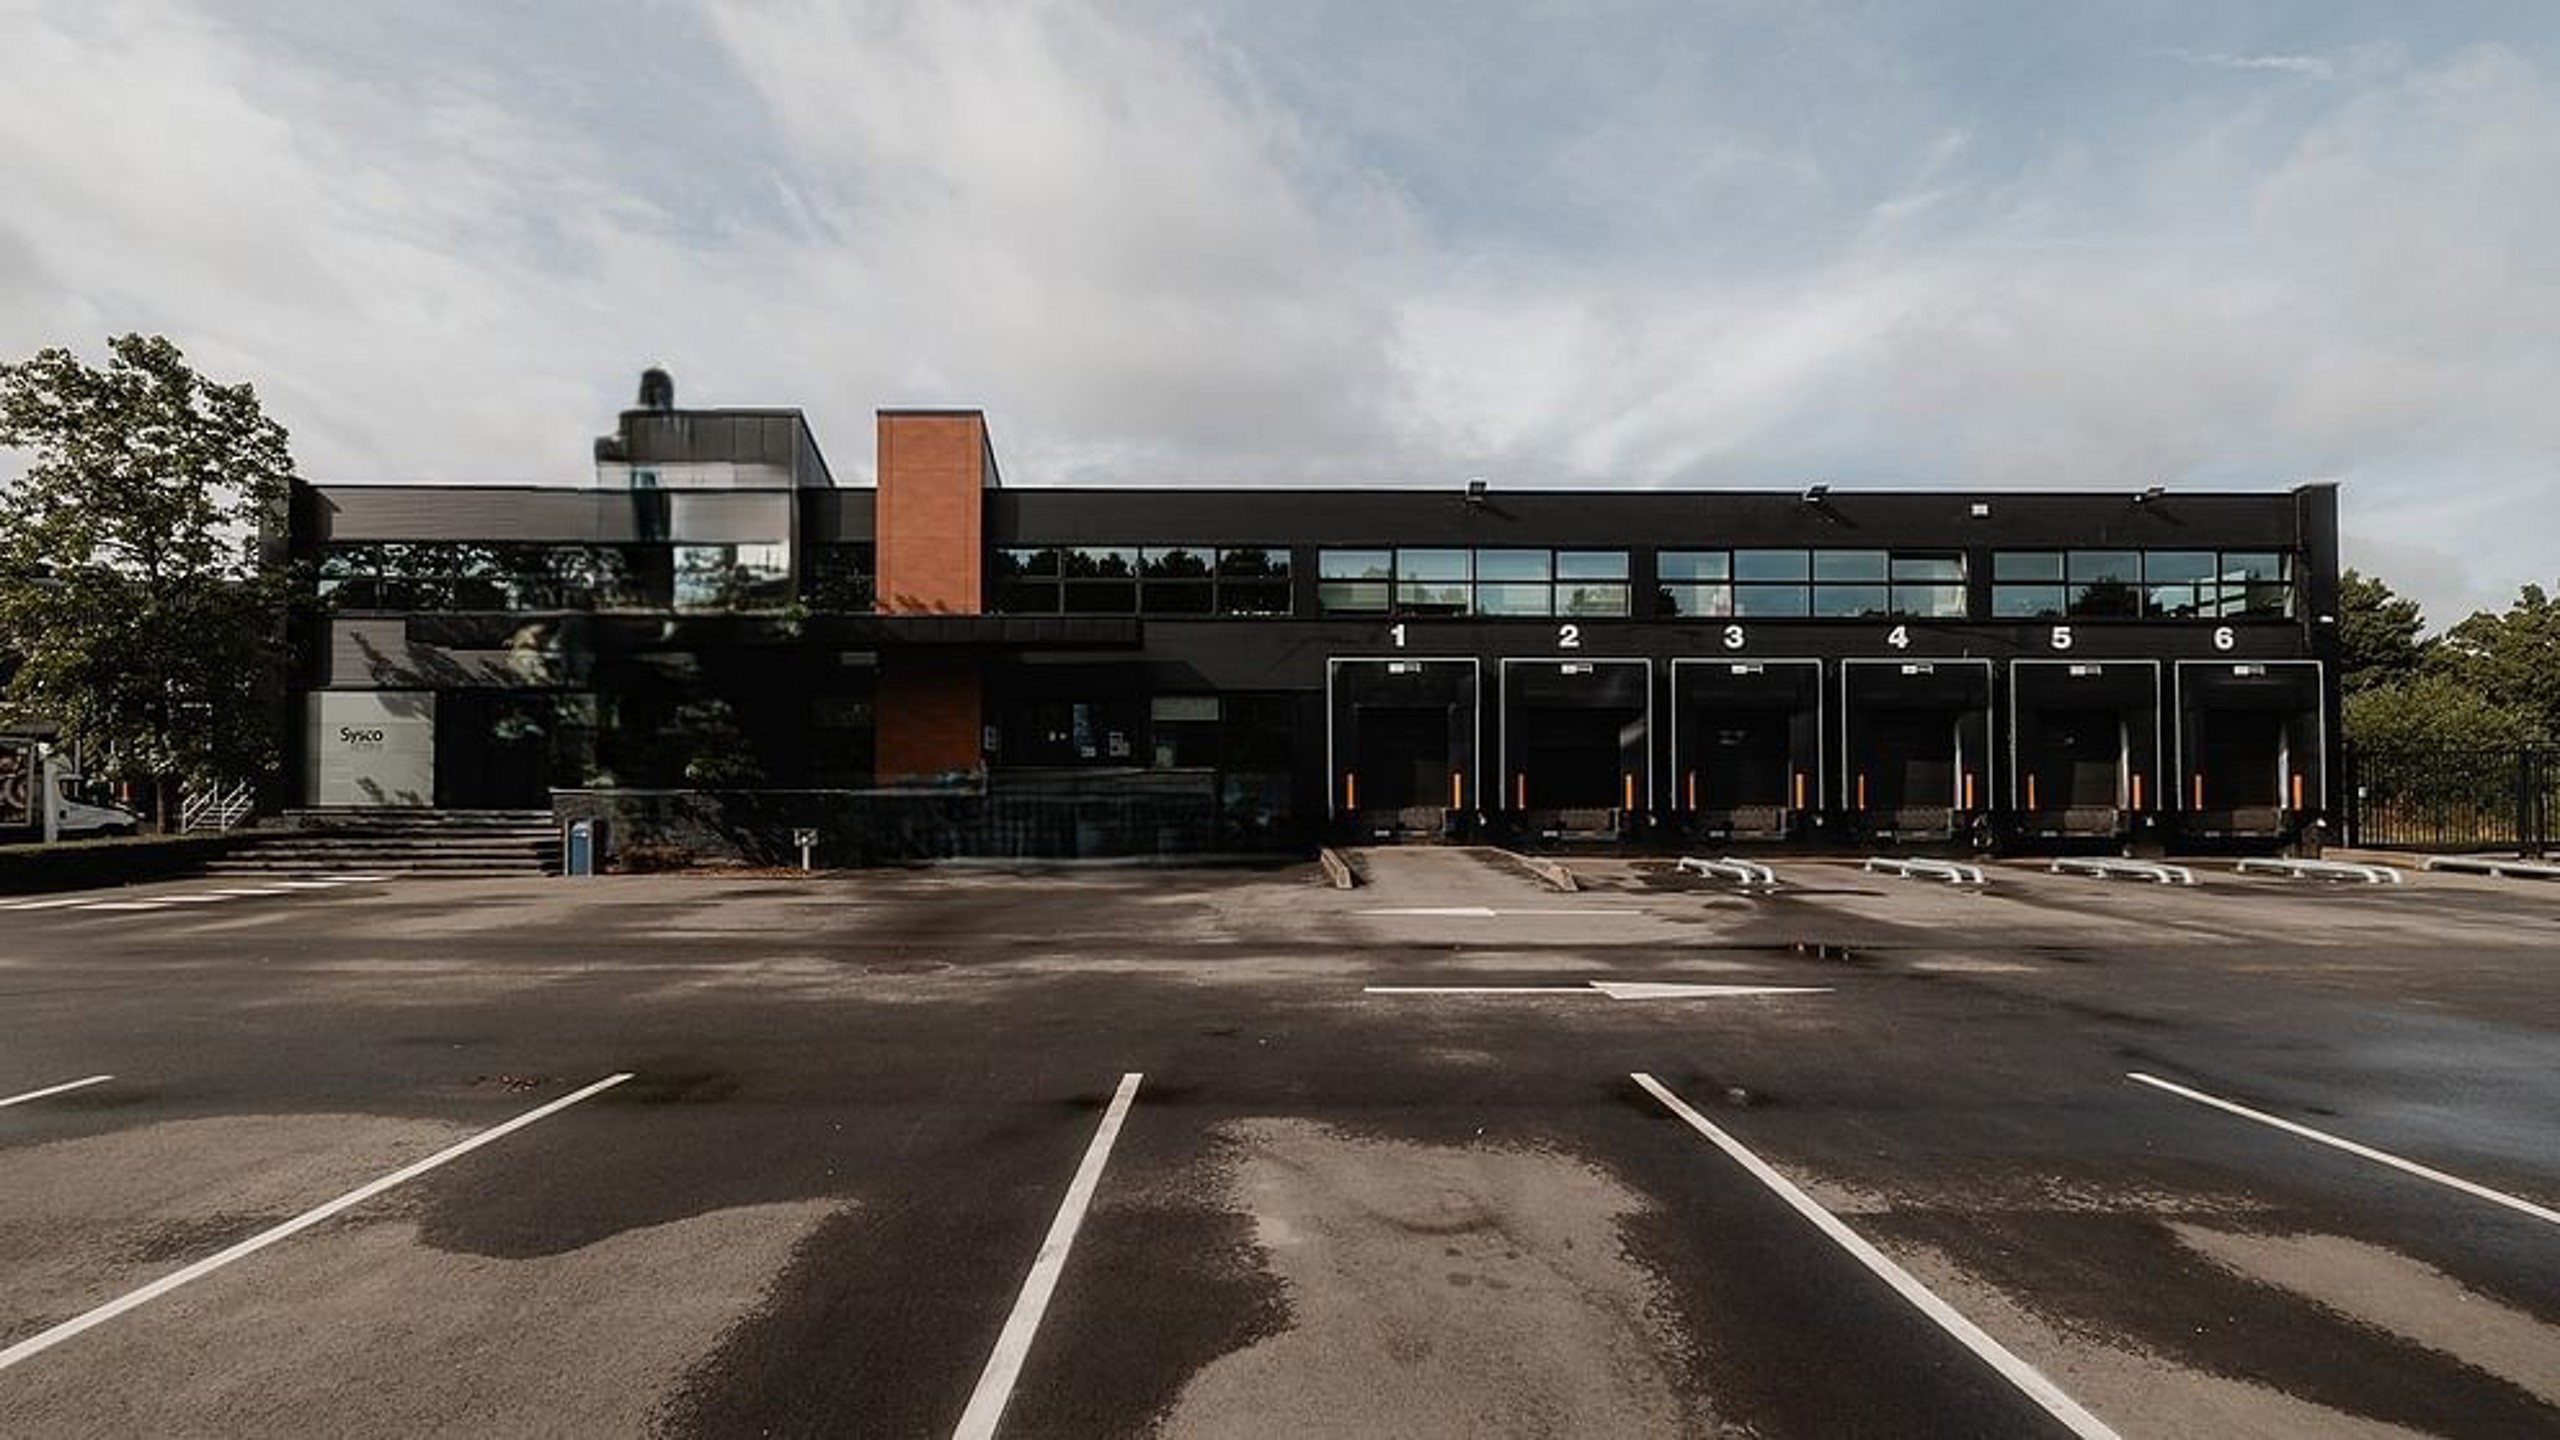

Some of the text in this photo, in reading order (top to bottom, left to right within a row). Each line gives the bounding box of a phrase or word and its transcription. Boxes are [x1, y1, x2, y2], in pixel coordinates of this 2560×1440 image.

[1390, 623, 1405, 647] 1
[1559, 624, 1580, 648] 2
[1724, 624, 1744, 649] 3
[1887, 625, 1909, 649] 4
[2051, 626, 2072, 649] 5
[2214, 626, 2234, 650] 6
[340, 727, 384, 745] Sysco
